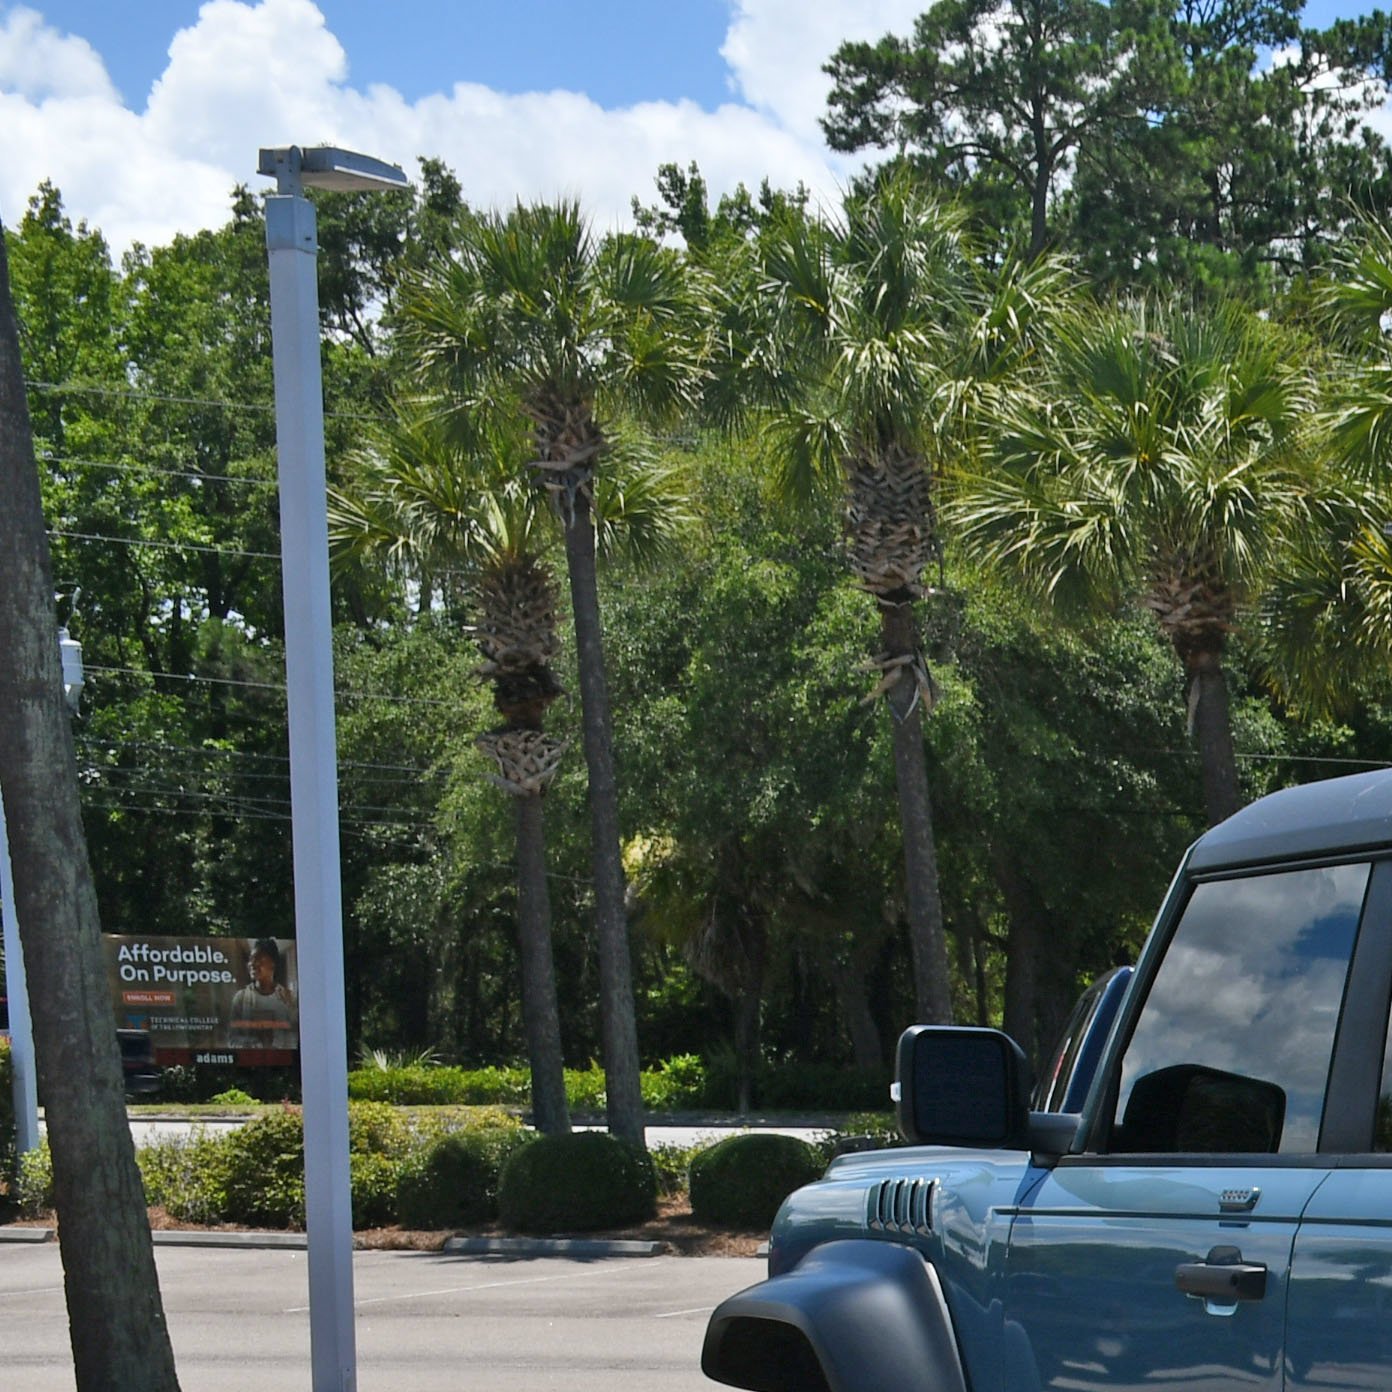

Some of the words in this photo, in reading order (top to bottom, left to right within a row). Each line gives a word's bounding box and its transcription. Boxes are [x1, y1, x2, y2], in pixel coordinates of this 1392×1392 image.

[118, 944, 229, 964] Affordable.
[120, 965, 149, 982] On
[154, 965, 237, 986] Purpose.
[196, 1053, 234, 1064] adams
